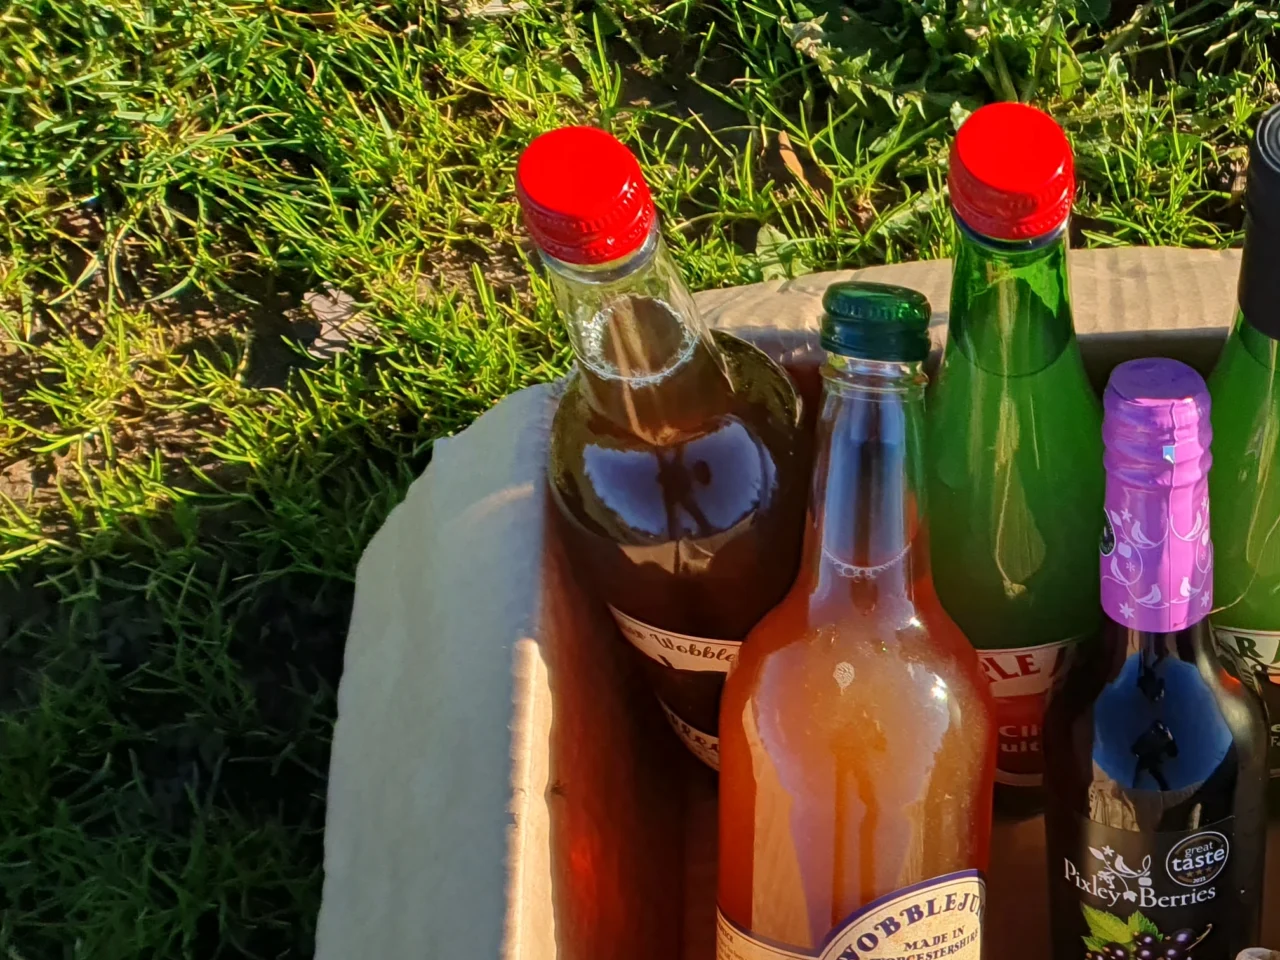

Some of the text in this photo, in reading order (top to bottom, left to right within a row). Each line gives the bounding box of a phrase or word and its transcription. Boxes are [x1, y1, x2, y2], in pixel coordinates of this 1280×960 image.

[1171, 848, 1225, 872] taste
[1185, 841, 1213, 858] great
[1063, 857, 1216, 908] Pixley Berries
[903, 925, 965, 952] MADE IN
